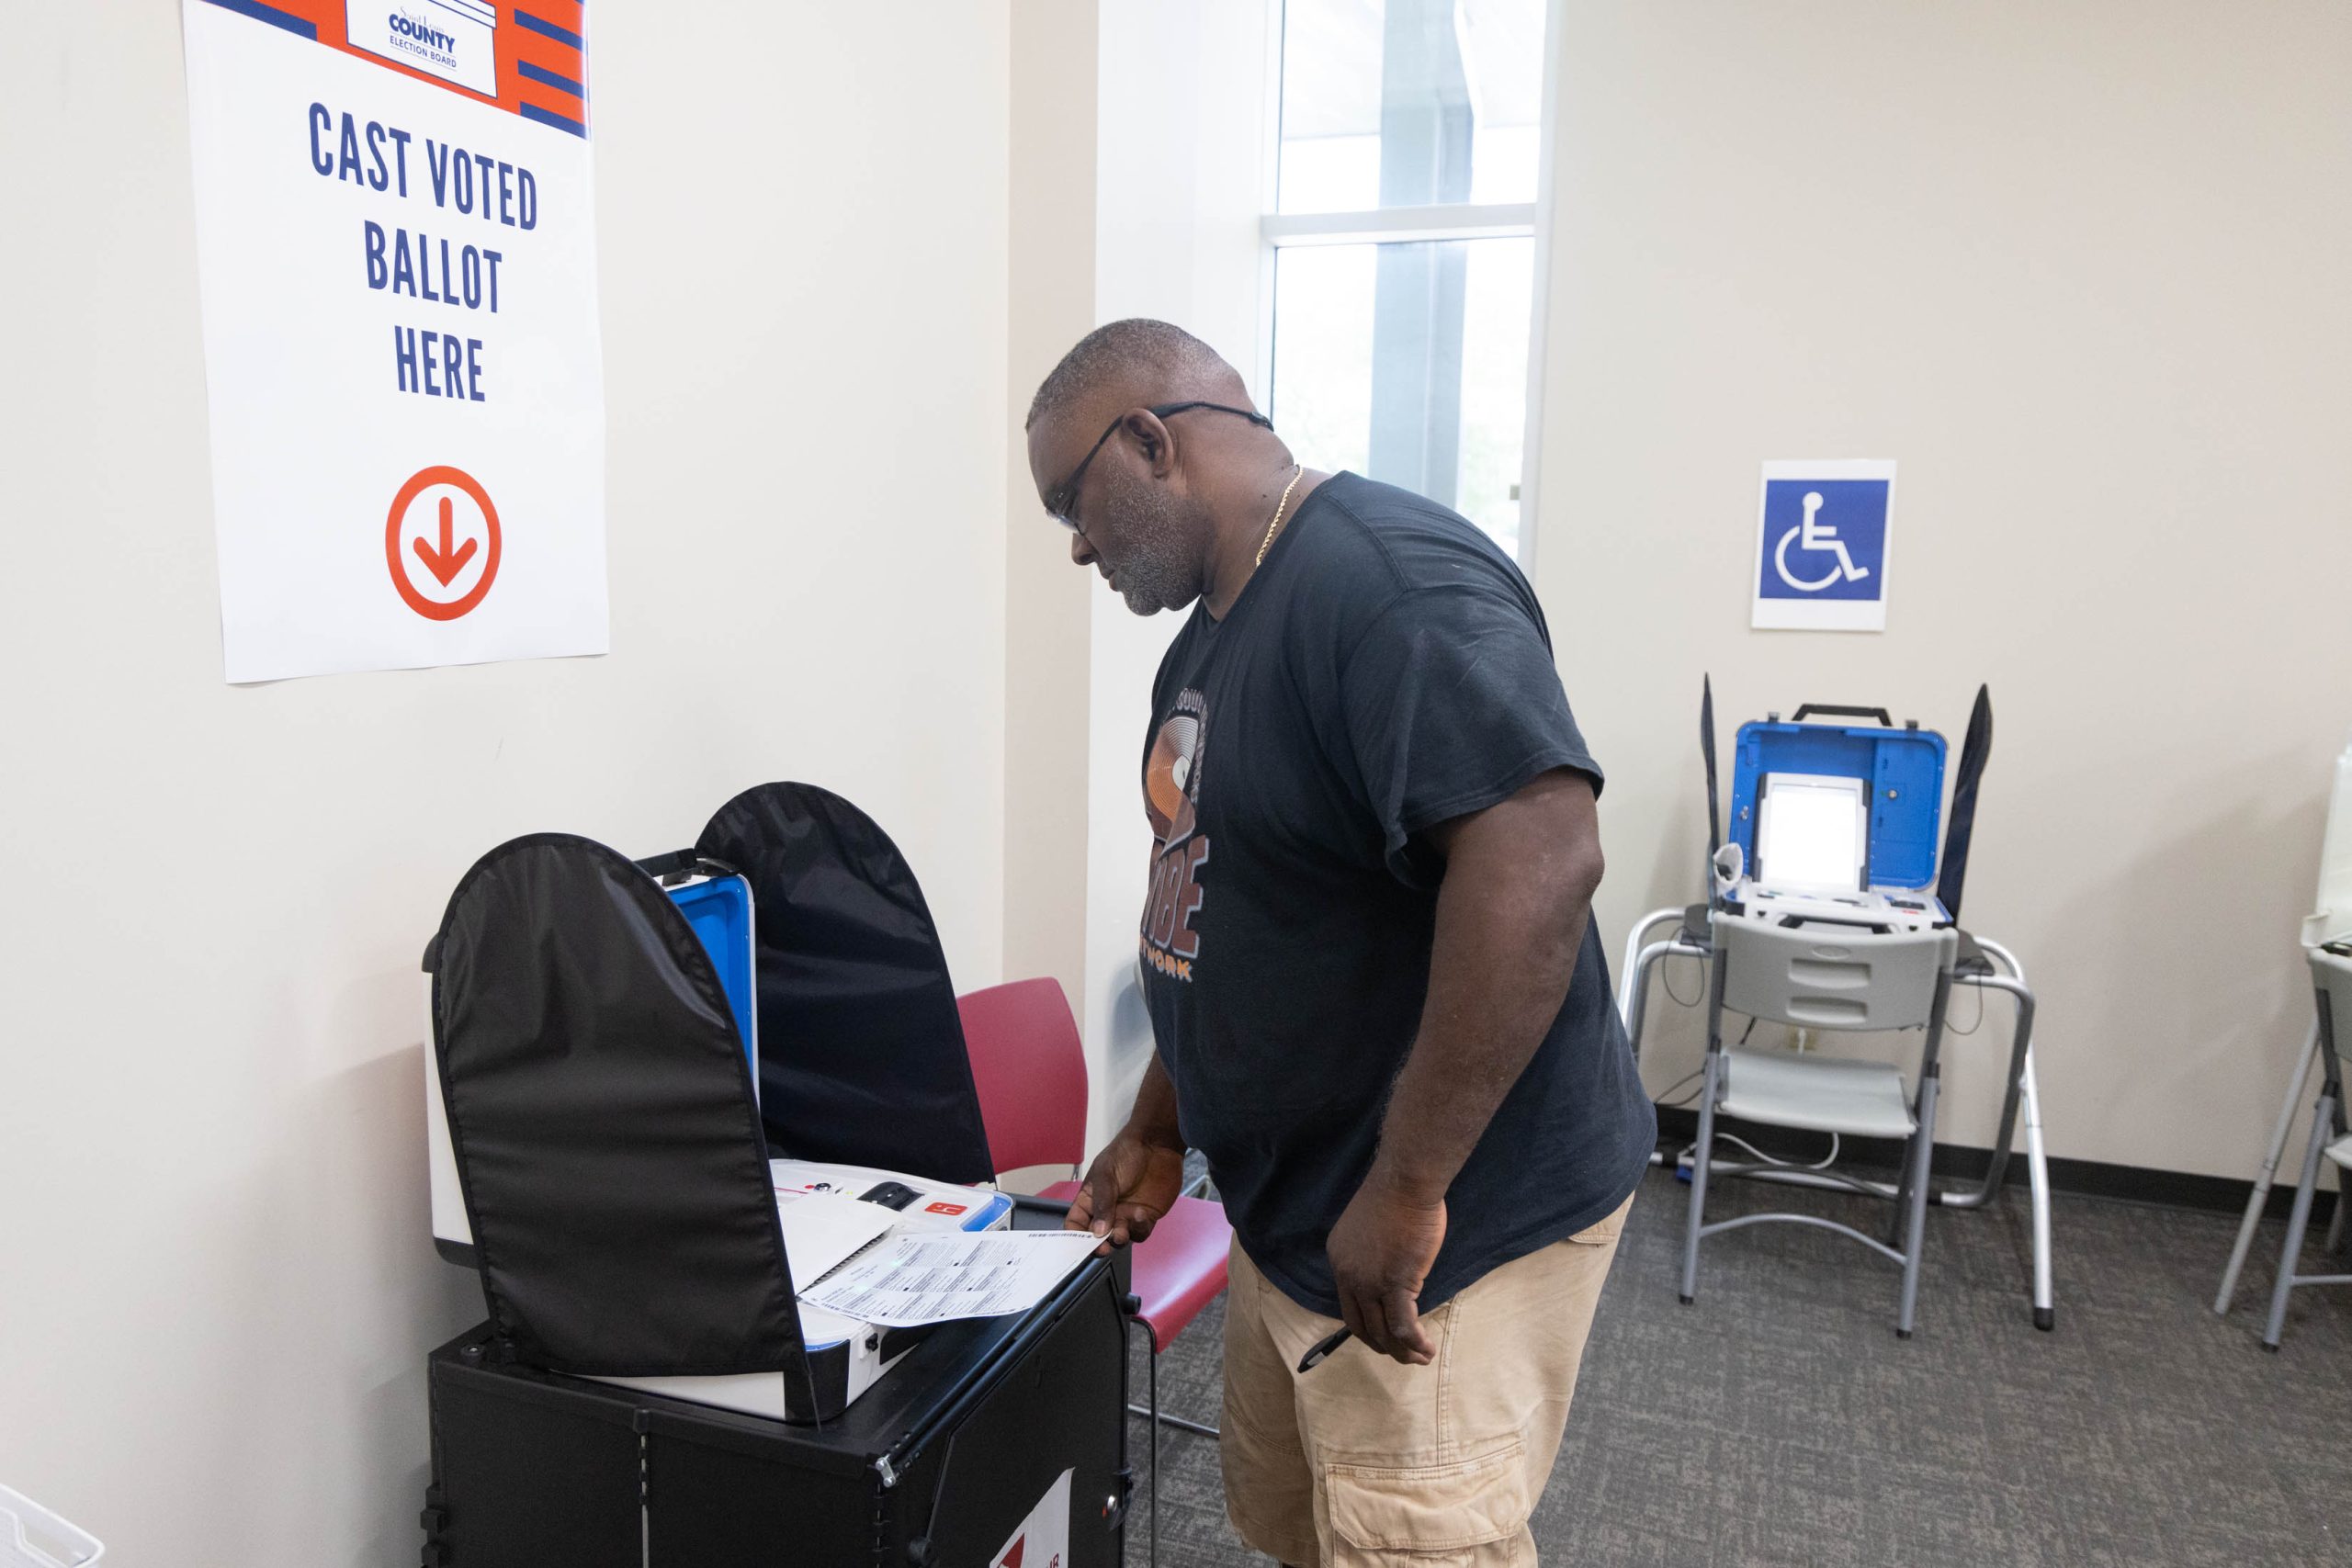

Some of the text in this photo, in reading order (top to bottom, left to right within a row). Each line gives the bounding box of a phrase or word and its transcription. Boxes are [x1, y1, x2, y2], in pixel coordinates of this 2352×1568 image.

[389, 14, 456, 53] COUNTY
[390, 35, 457, 68] ELECTION BOARD
[309, 102, 537, 231] CAST VOTED
[364, 220, 503, 313] BALLOT
[394, 325, 486, 402] HERE
